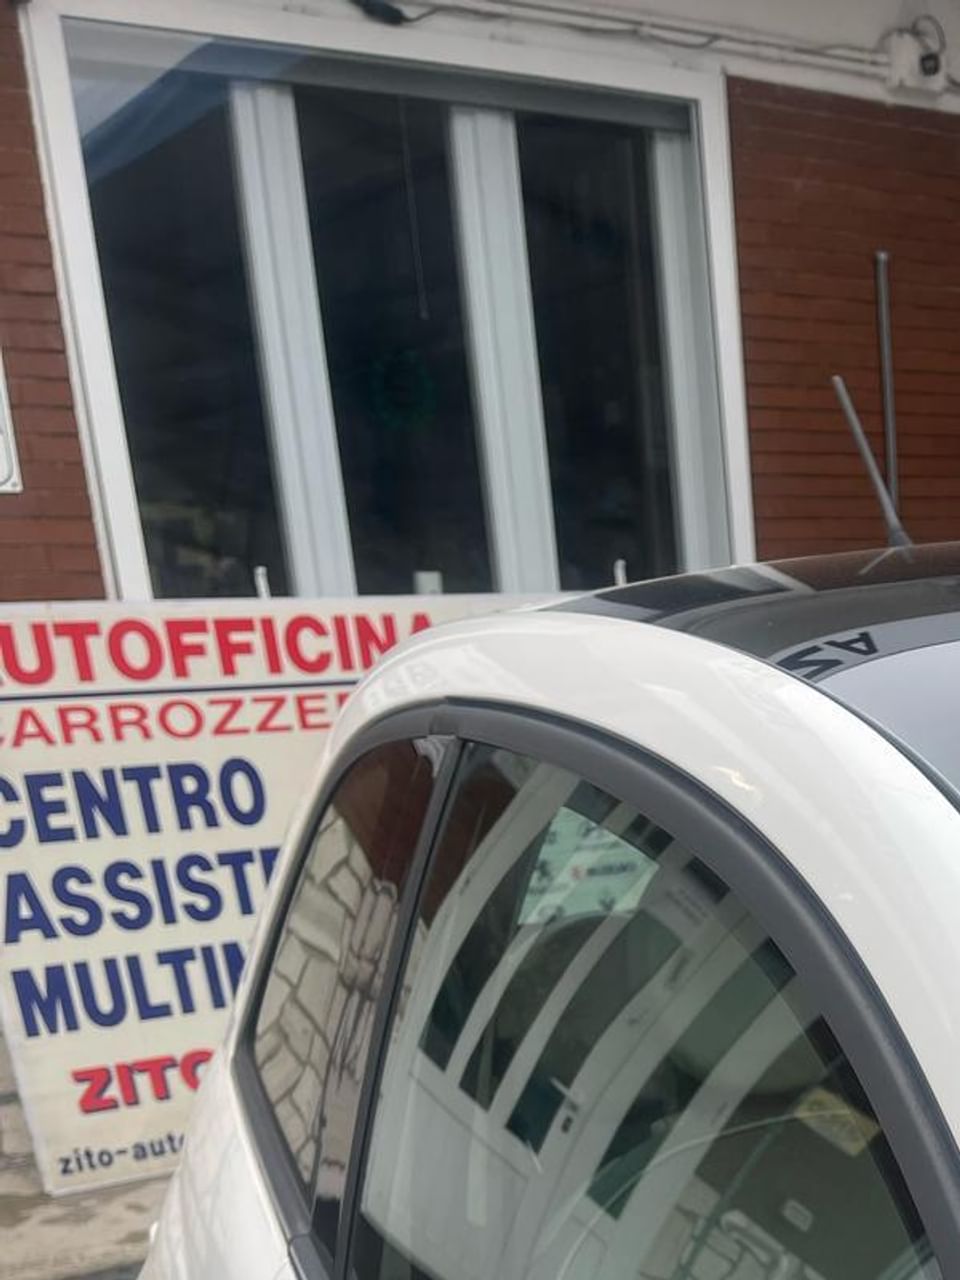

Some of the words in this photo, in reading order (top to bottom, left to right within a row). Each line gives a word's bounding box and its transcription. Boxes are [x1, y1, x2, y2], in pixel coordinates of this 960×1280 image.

[0, 611, 432, 685] UTOFFICIN
[0, 691, 350, 748] ARROZZE
[59, 1132, 184, 1175] zito-aut
